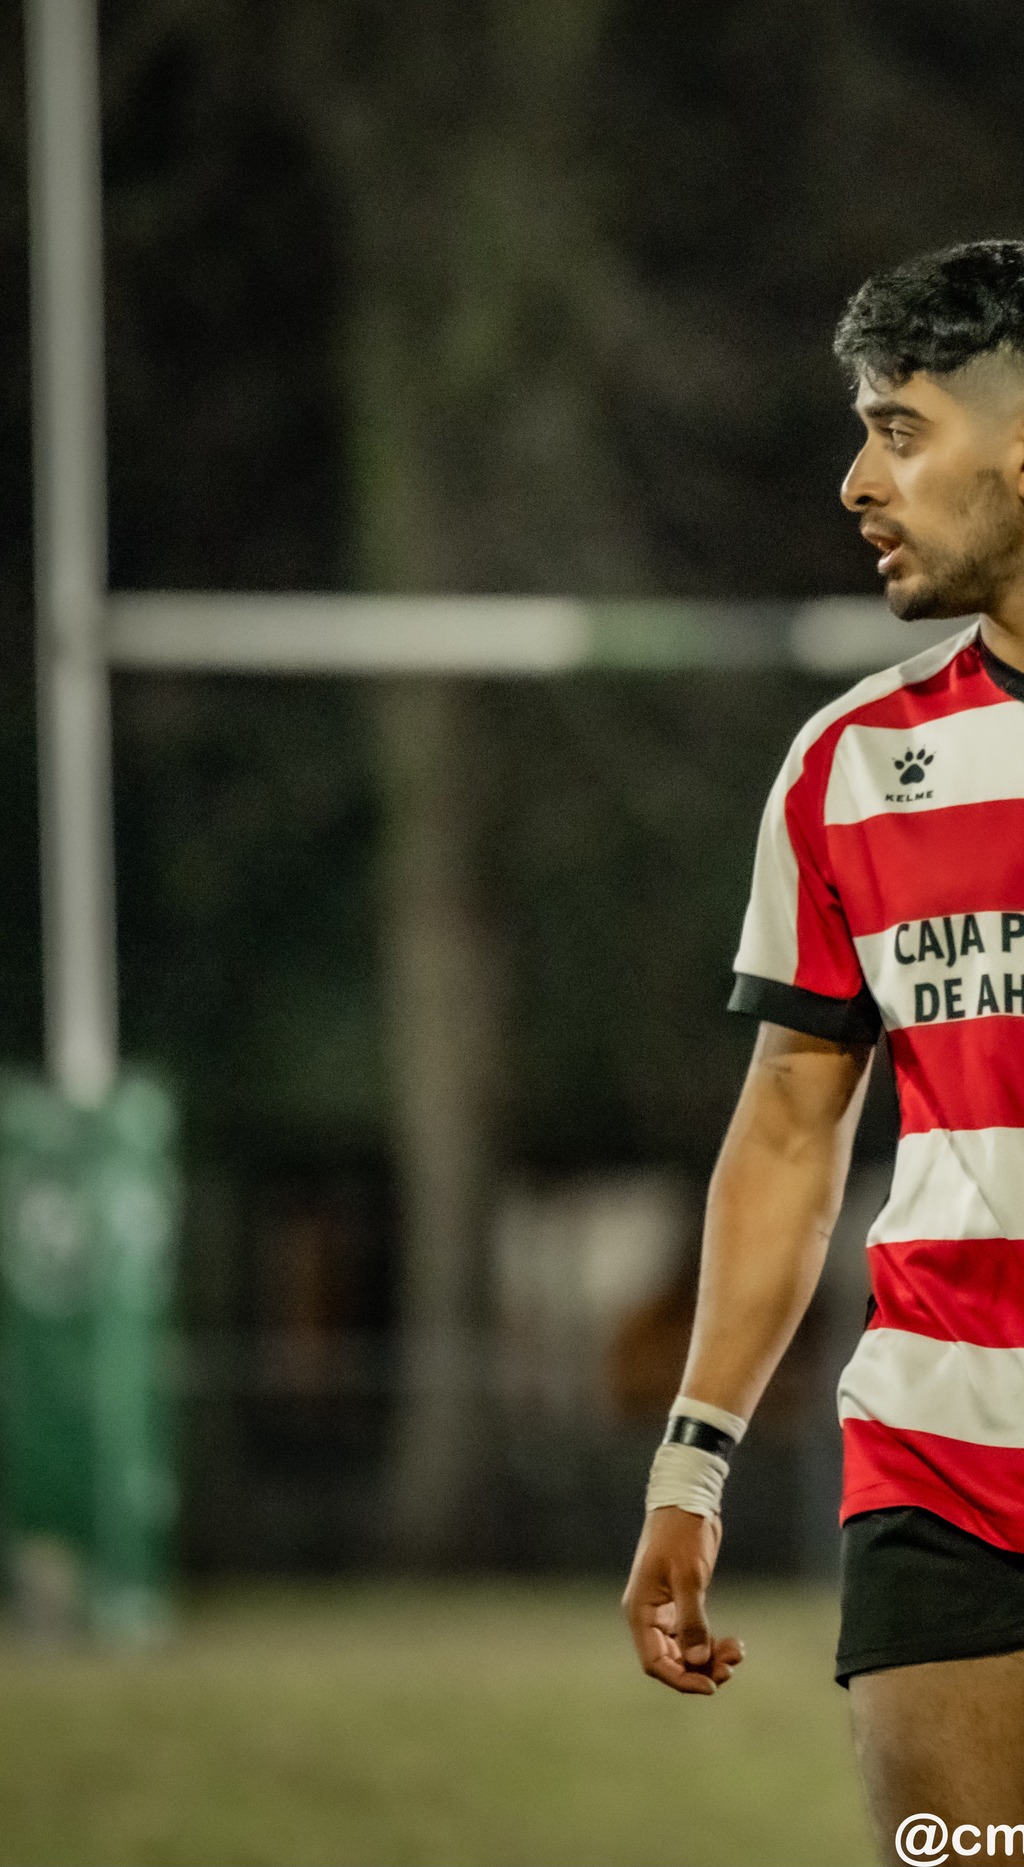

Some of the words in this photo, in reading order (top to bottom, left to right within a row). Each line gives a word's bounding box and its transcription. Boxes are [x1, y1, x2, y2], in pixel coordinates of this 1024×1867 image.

[885, 790, 934, 802] KELME
[894, 913, 985, 967] CAJA
[914, 977, 965, 1024] DE
